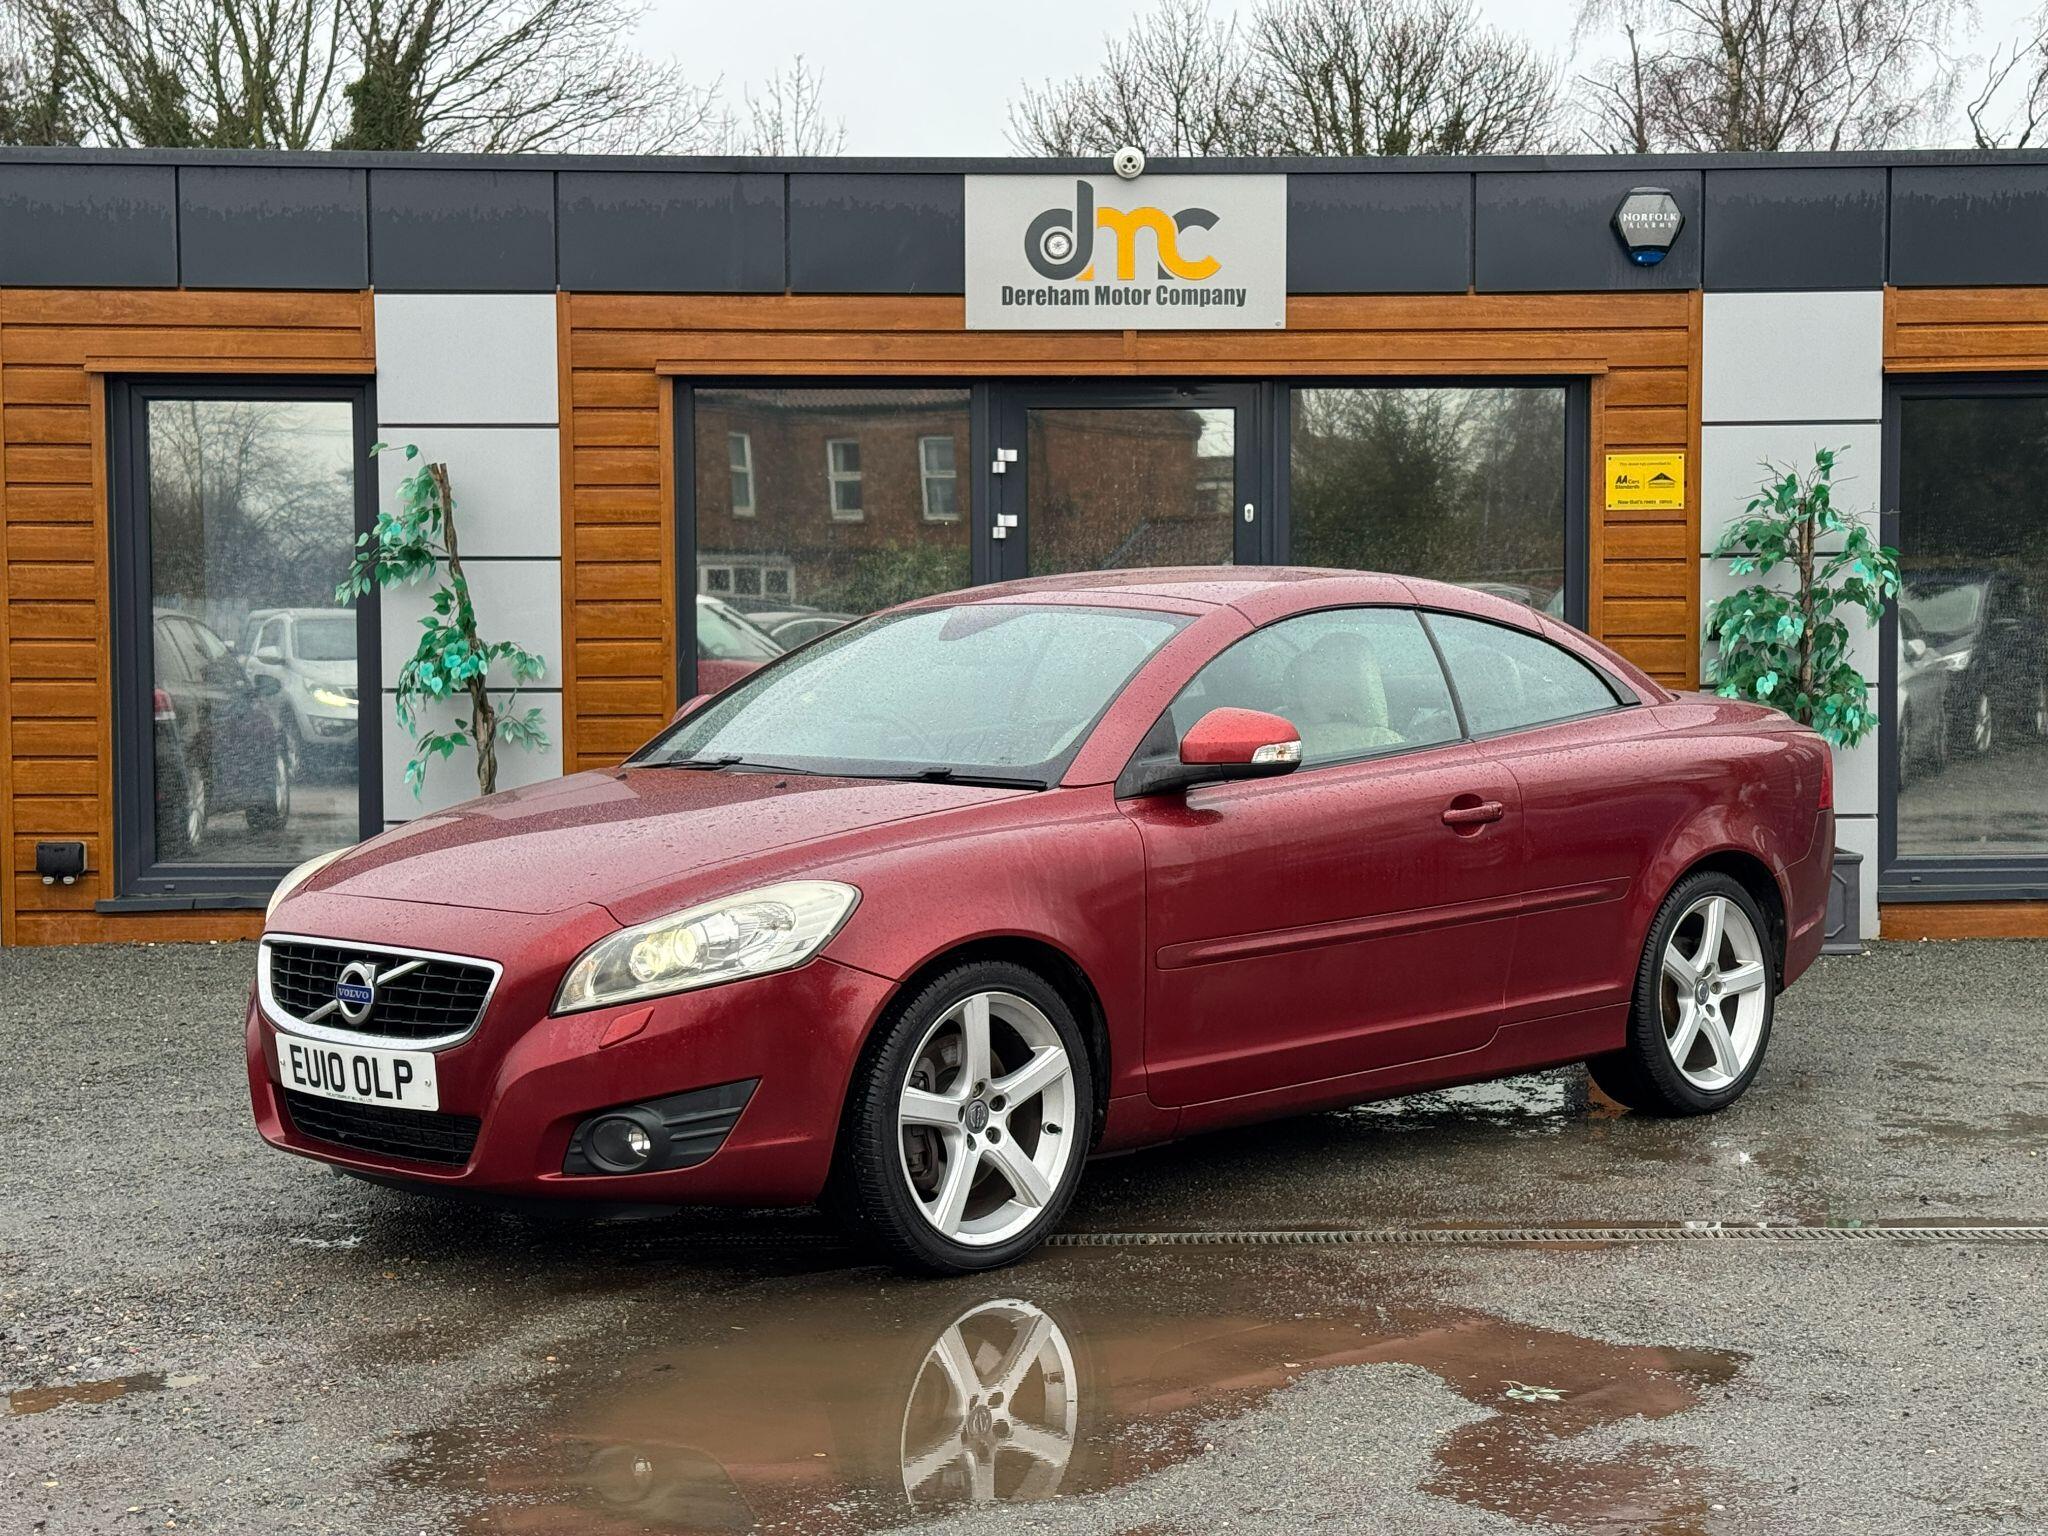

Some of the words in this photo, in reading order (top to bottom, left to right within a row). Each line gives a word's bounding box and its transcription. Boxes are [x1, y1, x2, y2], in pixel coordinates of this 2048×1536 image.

[1623, 212, 1677, 222] NORFOLK
[1024, 179, 1222, 281] dmc
[1001, 285, 1090, 307] Dereham
[1094, 285, 1152, 307] Motor
[1155, 285, 1247, 308] Company
[1616, 475, 1628, 484] AA
[338, 987, 370, 1000] VOLVO
[289, 1043, 346, 1093] EU10
[352, 1055, 414, 1101] OLP
